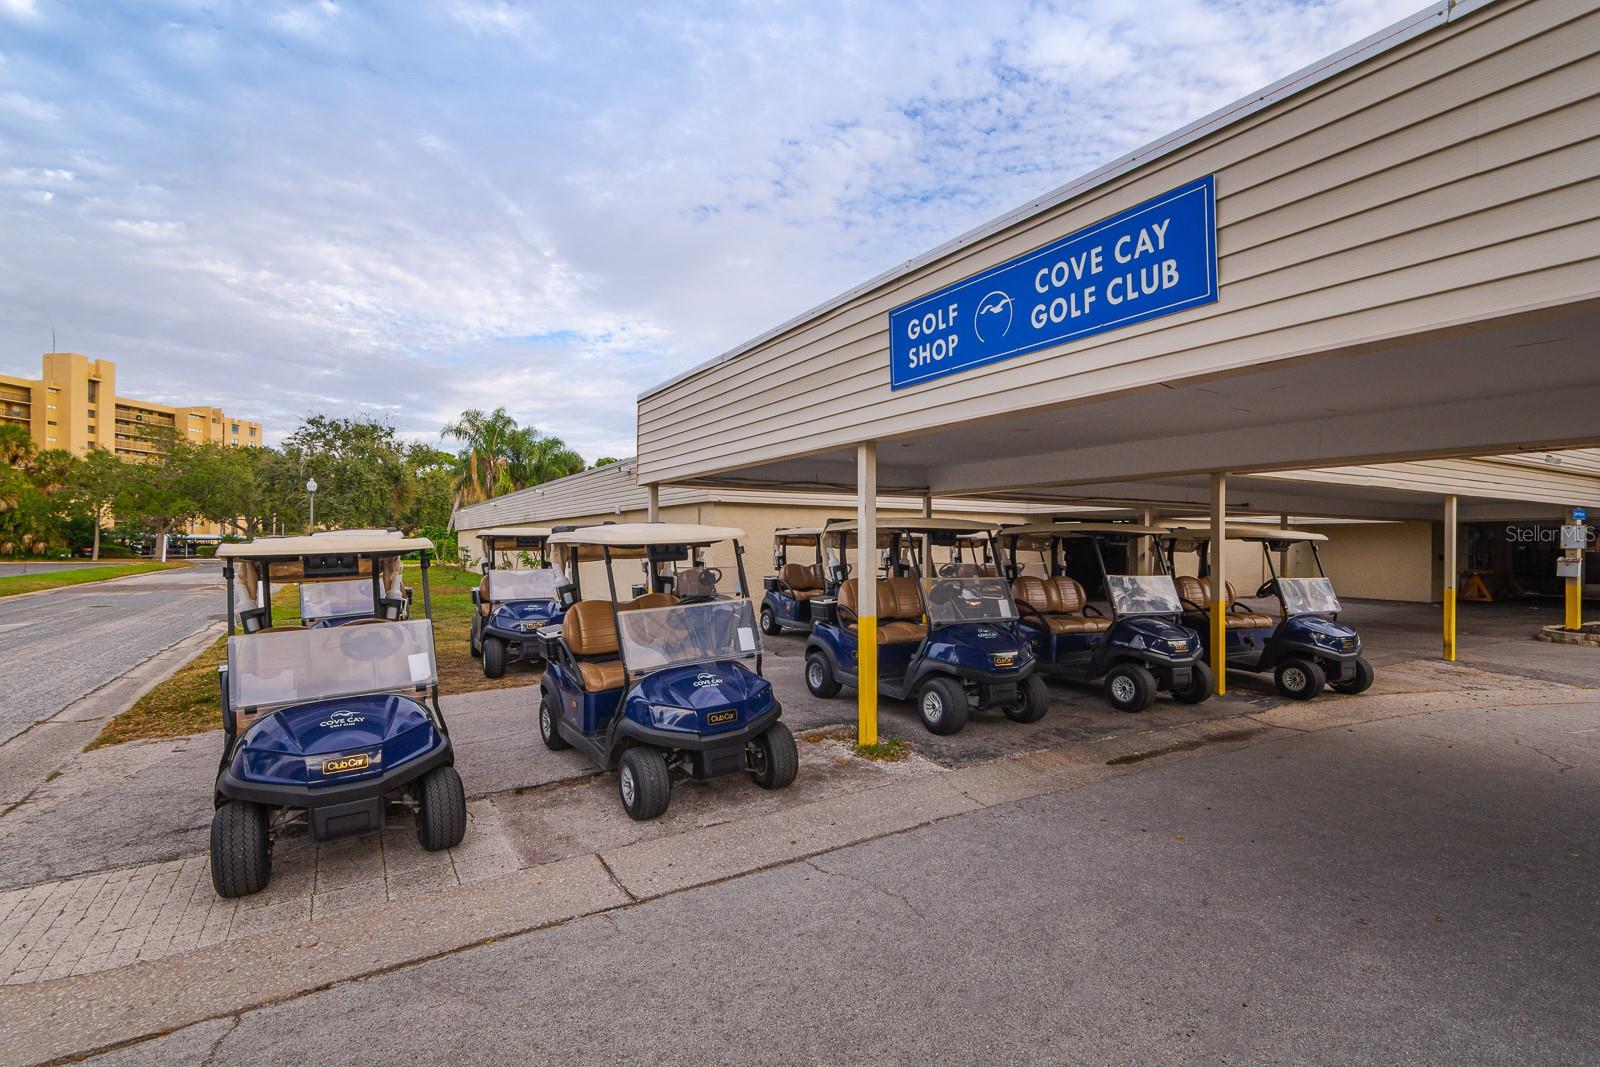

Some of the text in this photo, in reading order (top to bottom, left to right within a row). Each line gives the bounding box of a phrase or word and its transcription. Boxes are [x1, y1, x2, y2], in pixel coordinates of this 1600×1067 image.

[1034, 218, 1171, 294] COVE CAY
[1030, 259, 1180, 329] GOLF CLUB
[907, 304, 958, 340] GOLF
[908, 334, 959, 369] SHOP
[320, 719, 345, 727] COVE
[328, 758, 364, 770] Club Car
